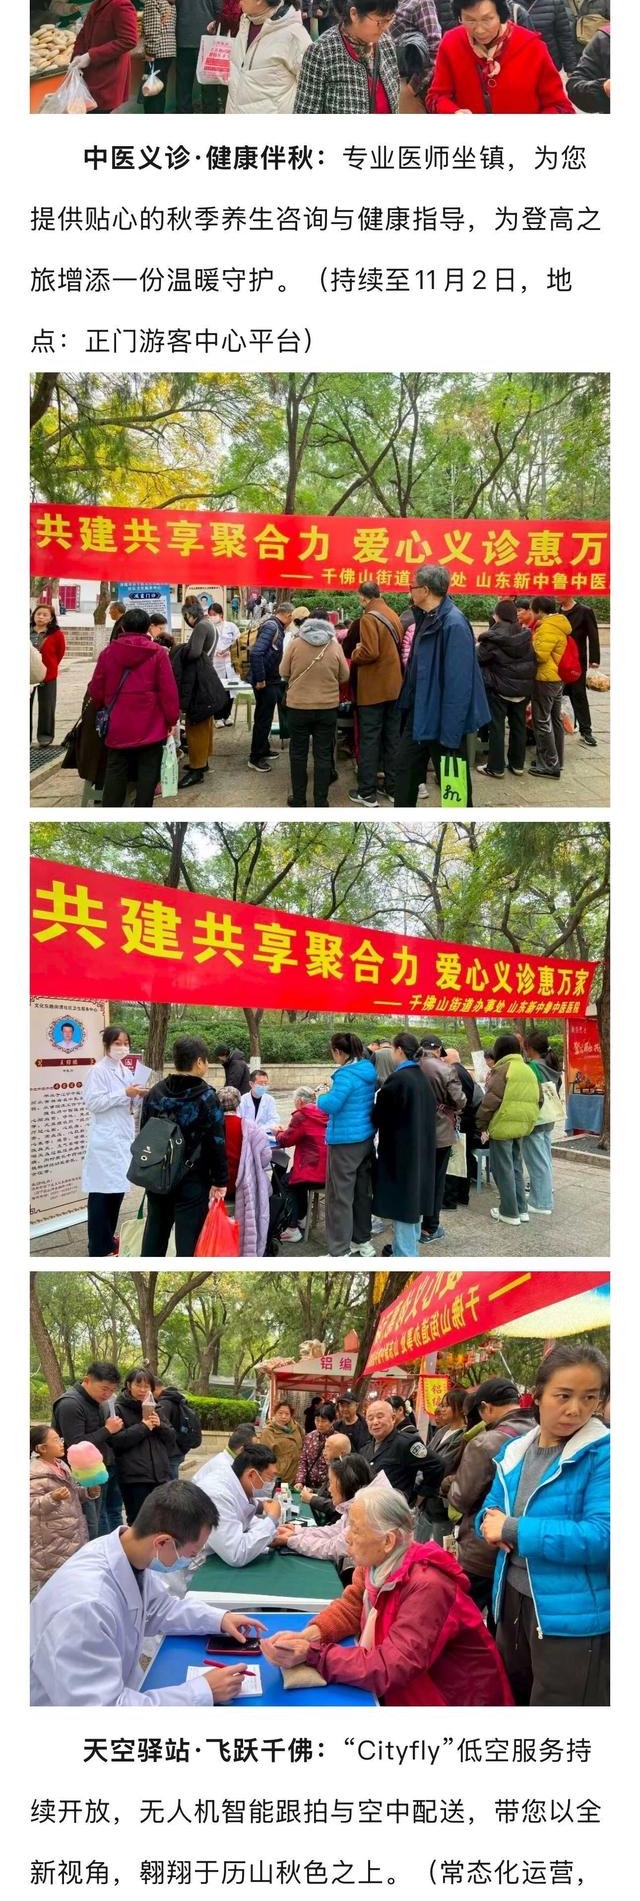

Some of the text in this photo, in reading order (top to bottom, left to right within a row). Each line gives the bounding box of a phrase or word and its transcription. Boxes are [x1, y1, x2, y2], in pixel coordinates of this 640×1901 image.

[31, 206, 600, 232] 提供贴心的秋季养生咨询与健康指导，为登高之
[31, 328, 315, 353] 点：正门游客中心平台）
[36, 513, 607, 566] 共建共享聚合力 爱心义诊惠万
[321, 568, 468, 588] 千佛山街道处
[33, 880, 590, 997] 共建共享聚合力 爱心义诊惠万家
[409, 994, 506, 1013] 千佛山街道办事处
[31, 1799, 601, 1825] 续开放，无人机智能跟拍与空中配送，带您以全
